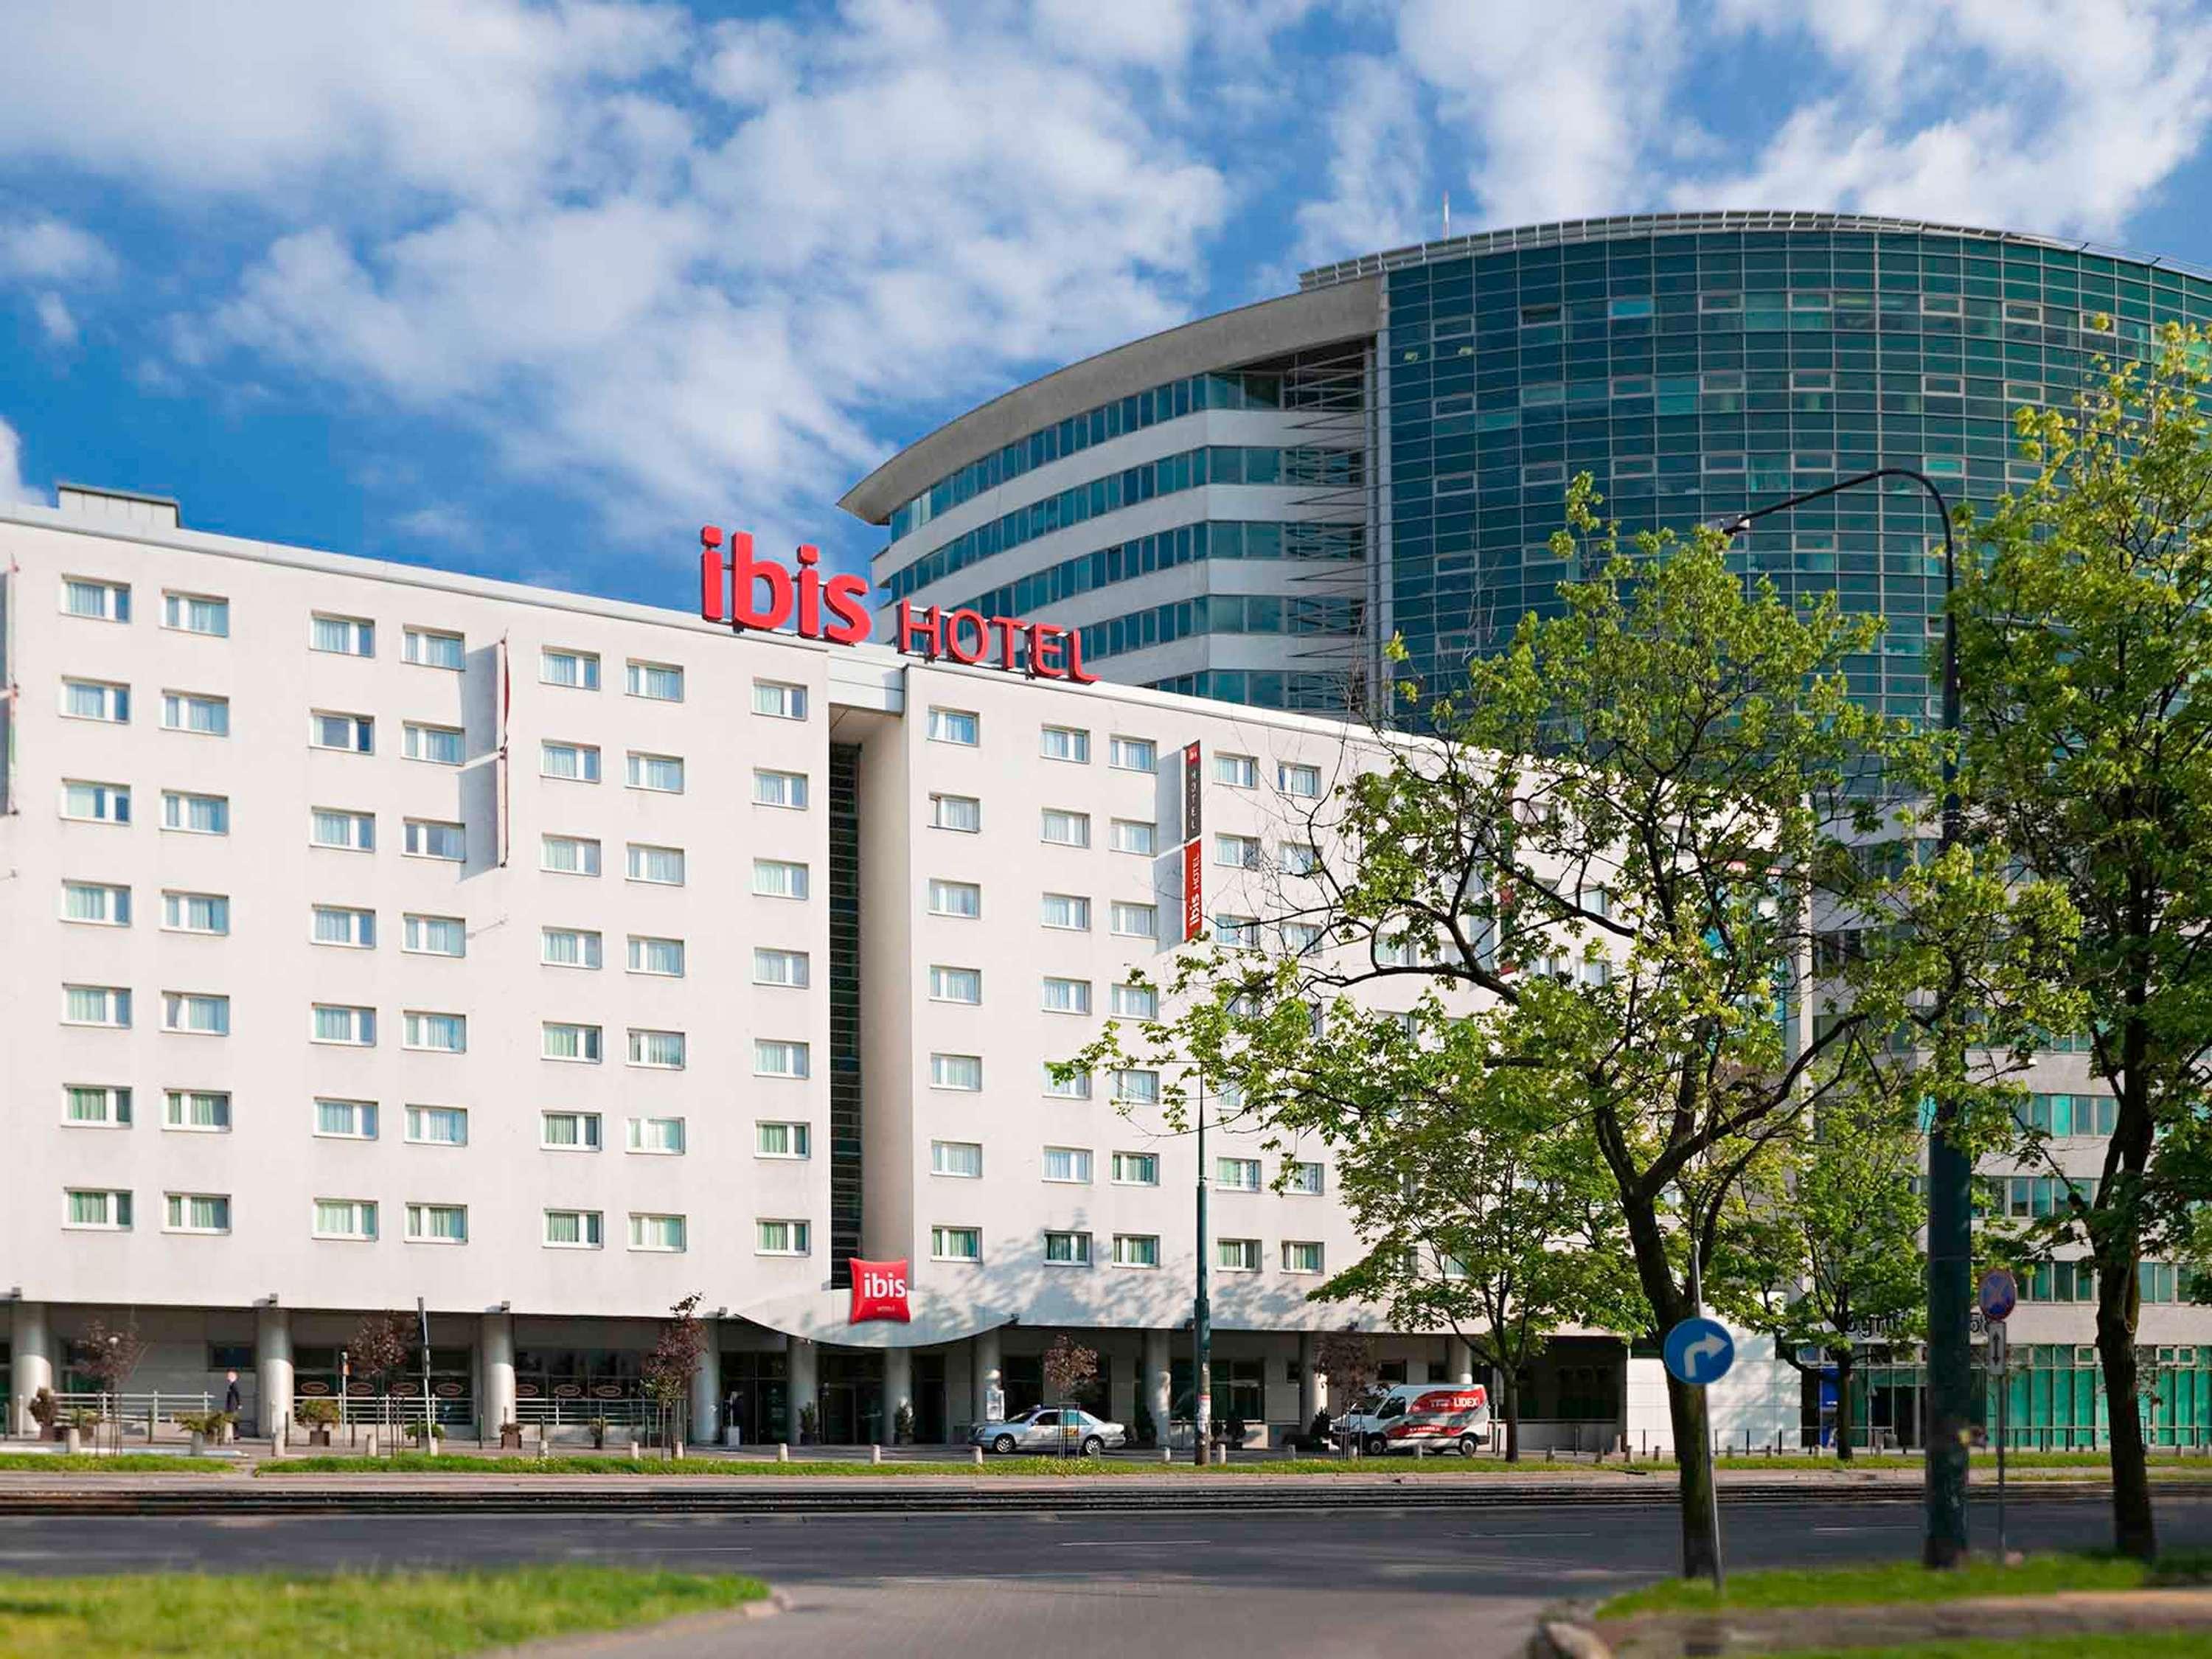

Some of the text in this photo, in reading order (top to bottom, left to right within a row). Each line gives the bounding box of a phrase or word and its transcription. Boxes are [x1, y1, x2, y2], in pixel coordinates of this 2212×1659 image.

[700, 525, 1102, 684] ibis HOTEL
[1189, 893, 1200, 926] ibis
[863, 1272, 907, 1298] ibis
